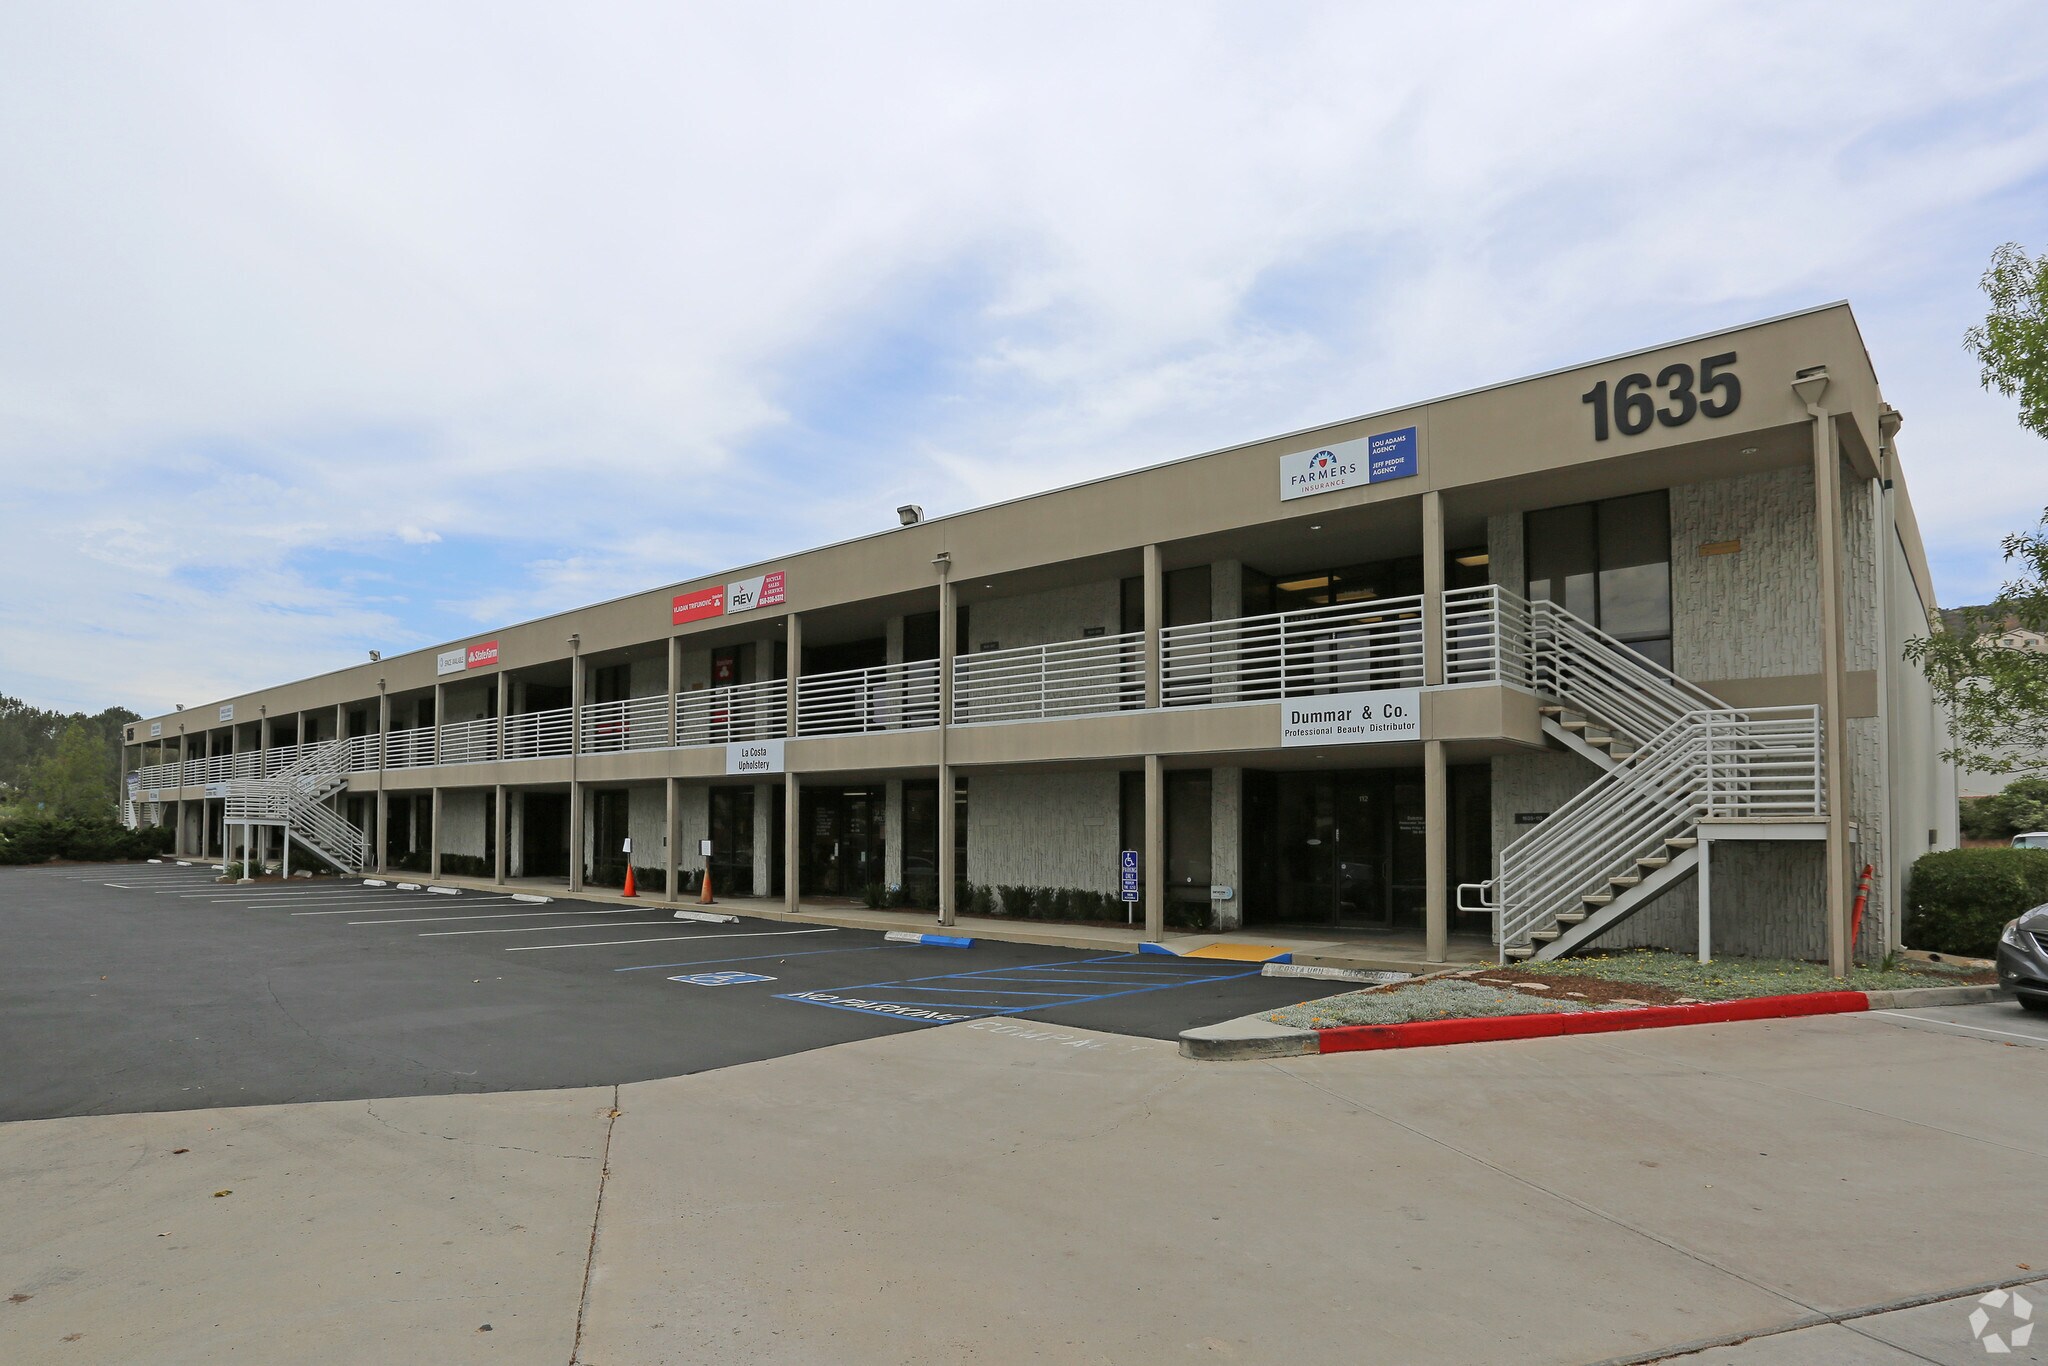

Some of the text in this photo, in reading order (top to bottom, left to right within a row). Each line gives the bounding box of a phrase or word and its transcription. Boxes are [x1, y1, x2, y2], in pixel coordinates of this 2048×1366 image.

[1582, 351, 1741, 441] 1635
[1384, 435, 1406, 446] ADAMS
[1372, 445, 1396, 454] AGENCY
[1372, 456, 1404, 468] JEFF PEDDIE
[1291, 463, 1356, 486] FARMERS
[1372, 466, 1397, 476] AGENCY
[1302, 479, 1345, 492] INSURANCE
[733, 592, 754, 606] REV
[1292, 704, 1408, 724] Dummar & Co.
[1284, 722, 1415, 737] Professional Beauty Distributor
[742, 747, 766, 757] La Costa
[738, 760, 769, 771] Upholstery
[830, 999, 970, 1020] PARKING
